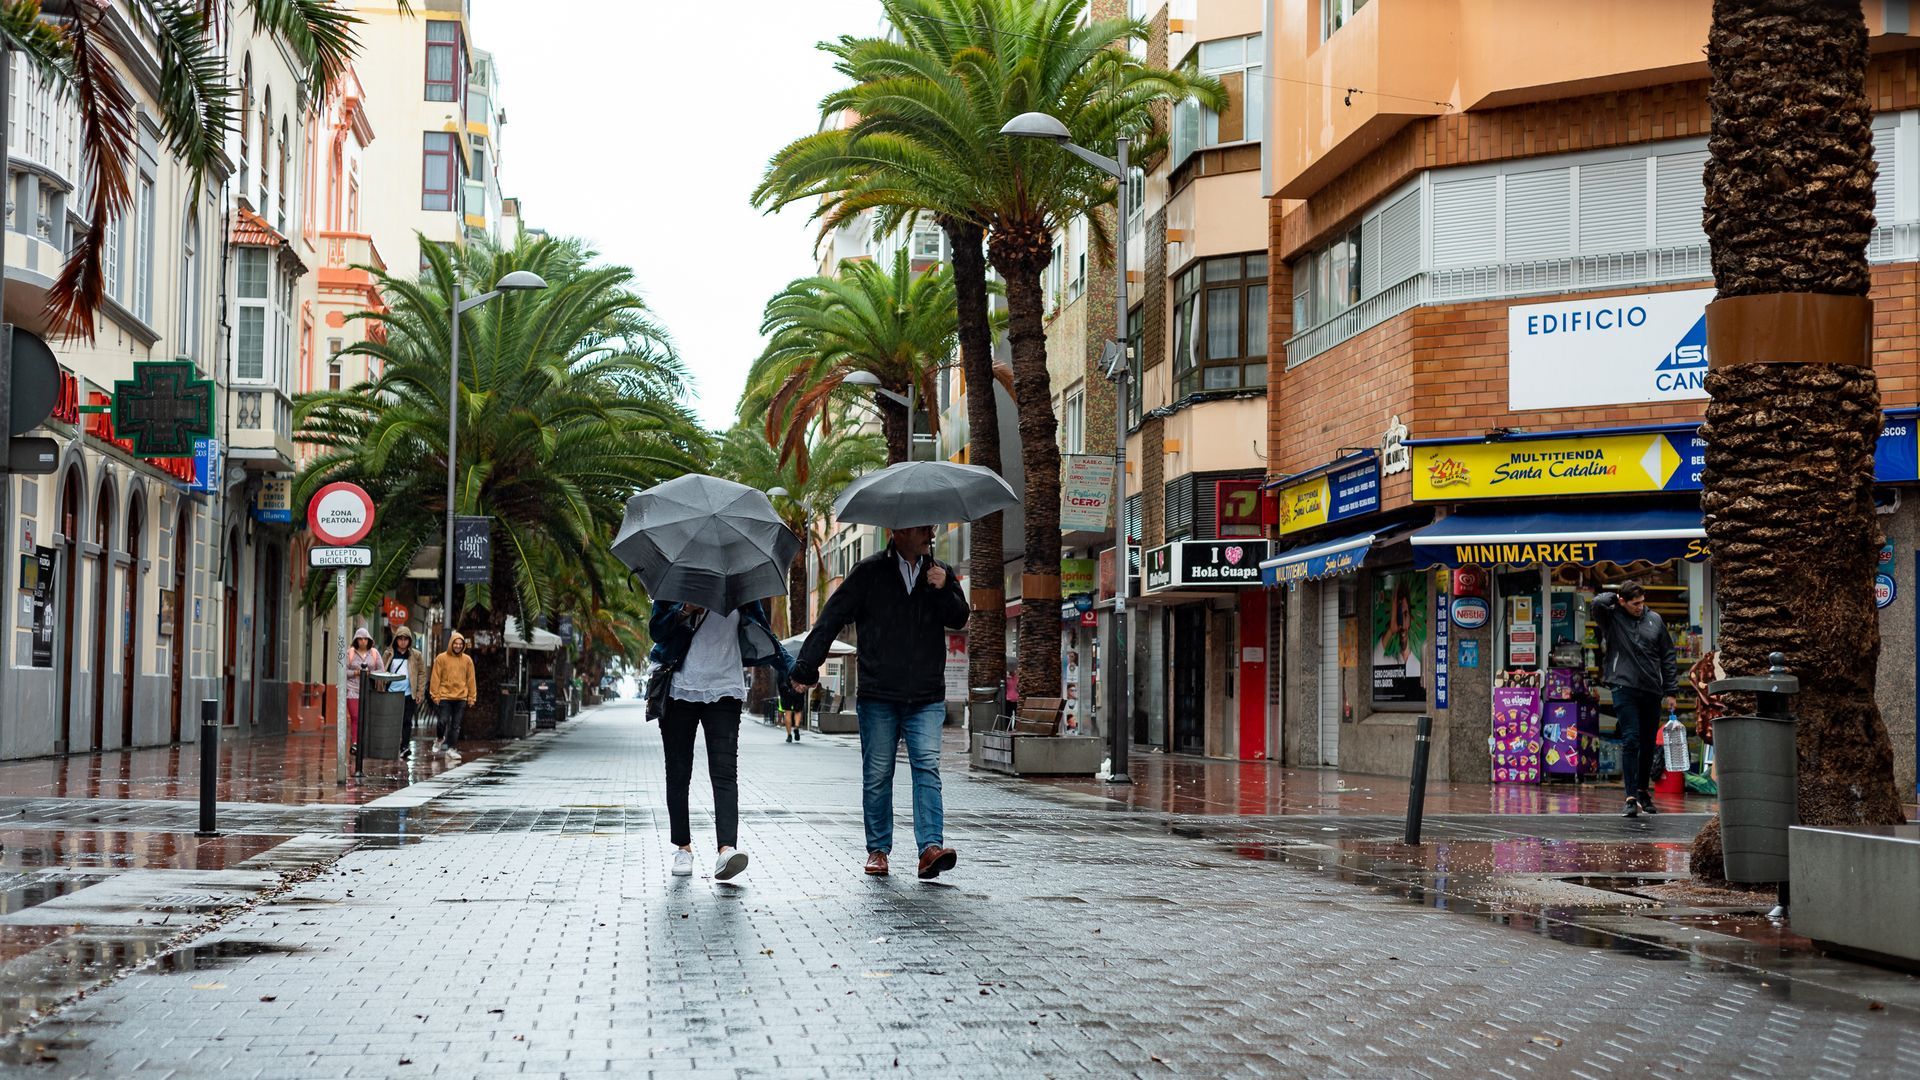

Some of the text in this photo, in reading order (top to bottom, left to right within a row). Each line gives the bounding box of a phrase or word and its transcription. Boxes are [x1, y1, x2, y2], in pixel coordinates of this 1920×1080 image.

[1528, 306, 1647, 335] EDIFICIO
[1656, 371, 1708, 392] CAN
[1510, 449, 1604, 465] MULTITIENDA
[1433, 461, 1463, 478] 24H
[1490, 461, 1616, 485] Santa Catalina
[1071, 498, 1101, 507] CERO
[263, 511, 285, 519] Blanco
[1211, 547, 1219, 563] I
[1456, 543, 1598, 563] MINIMARKET
[1192, 566, 1258, 579] Hola Guapa
[1276, 561, 1309, 581] MULTITIENDA
[389, 608, 406, 618] ria
